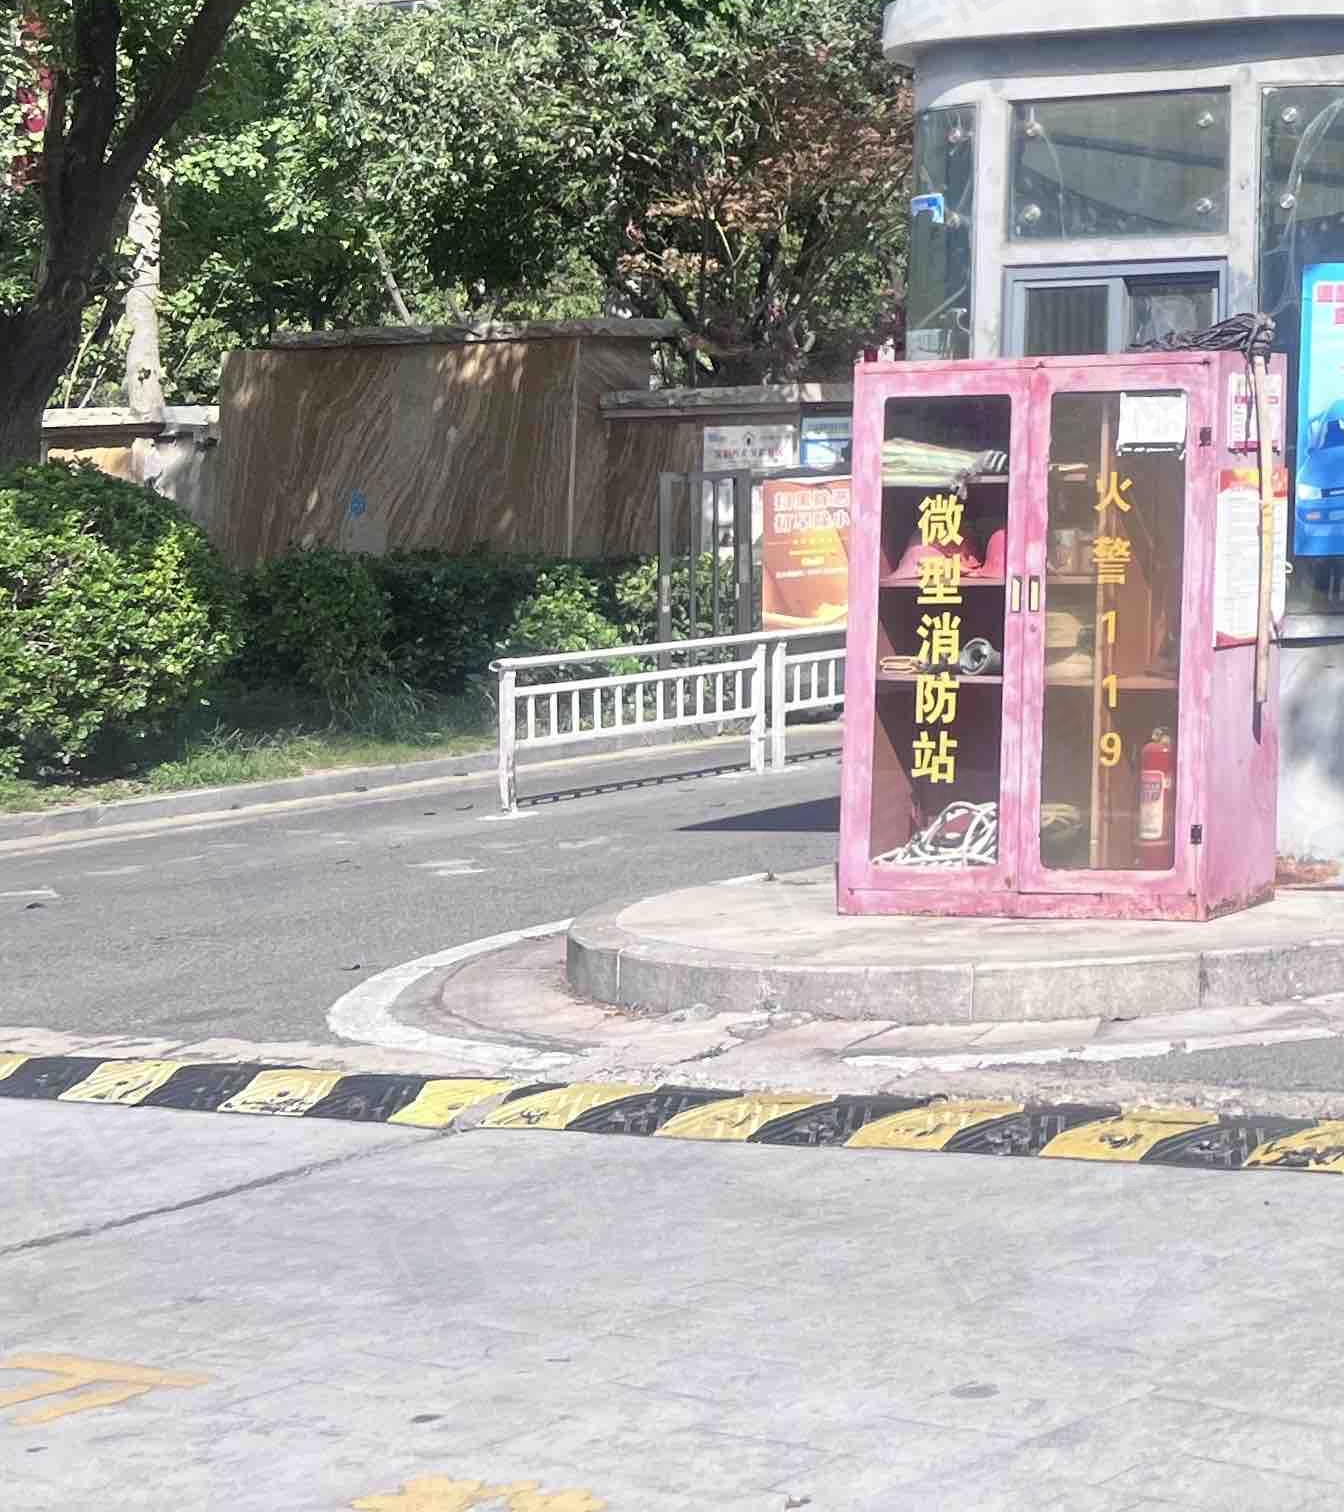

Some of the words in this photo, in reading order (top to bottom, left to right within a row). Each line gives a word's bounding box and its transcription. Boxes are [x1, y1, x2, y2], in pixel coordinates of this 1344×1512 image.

[911, 493, 966, 785] 微型消防站
